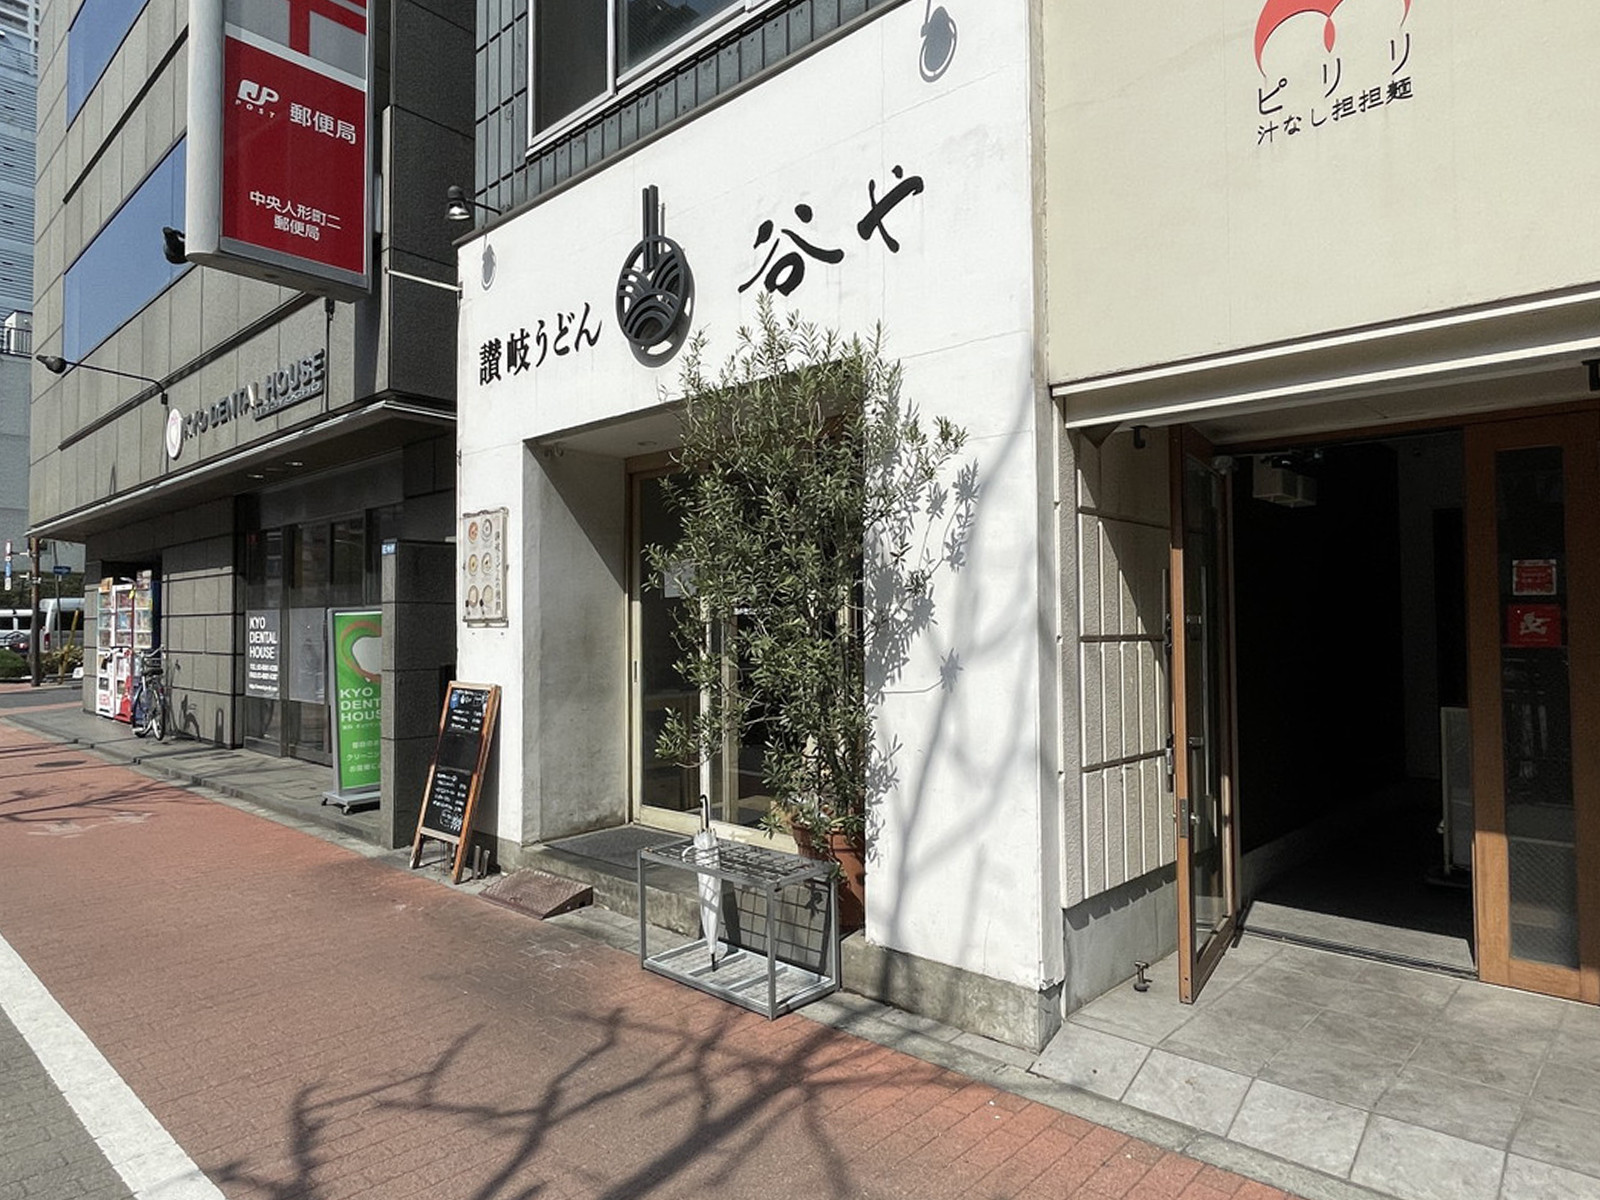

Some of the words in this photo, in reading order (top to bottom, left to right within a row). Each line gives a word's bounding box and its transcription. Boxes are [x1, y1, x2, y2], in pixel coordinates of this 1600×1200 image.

[1258, 32, 1411, 115] ピリリ
[235, 99, 276, 119] POST
[289, 101, 357, 145] 郵便局
[249, 190, 342, 231] 中央人形町二
[273, 214, 321, 242] 郵便局
[737, 164, 925, 297] 谷や
[479, 301, 603, 387] 讃岐うどん
[181, 408, 209, 442] KYO
[208, 381, 264, 429] DENTAL
[265, 348, 326, 403] HOUSE
[249, 616, 266, 630] KYO
[249, 631, 278, 645] DENTAL
[249, 645, 276, 660] HOUSE
[340, 686, 374, 699] KYO
